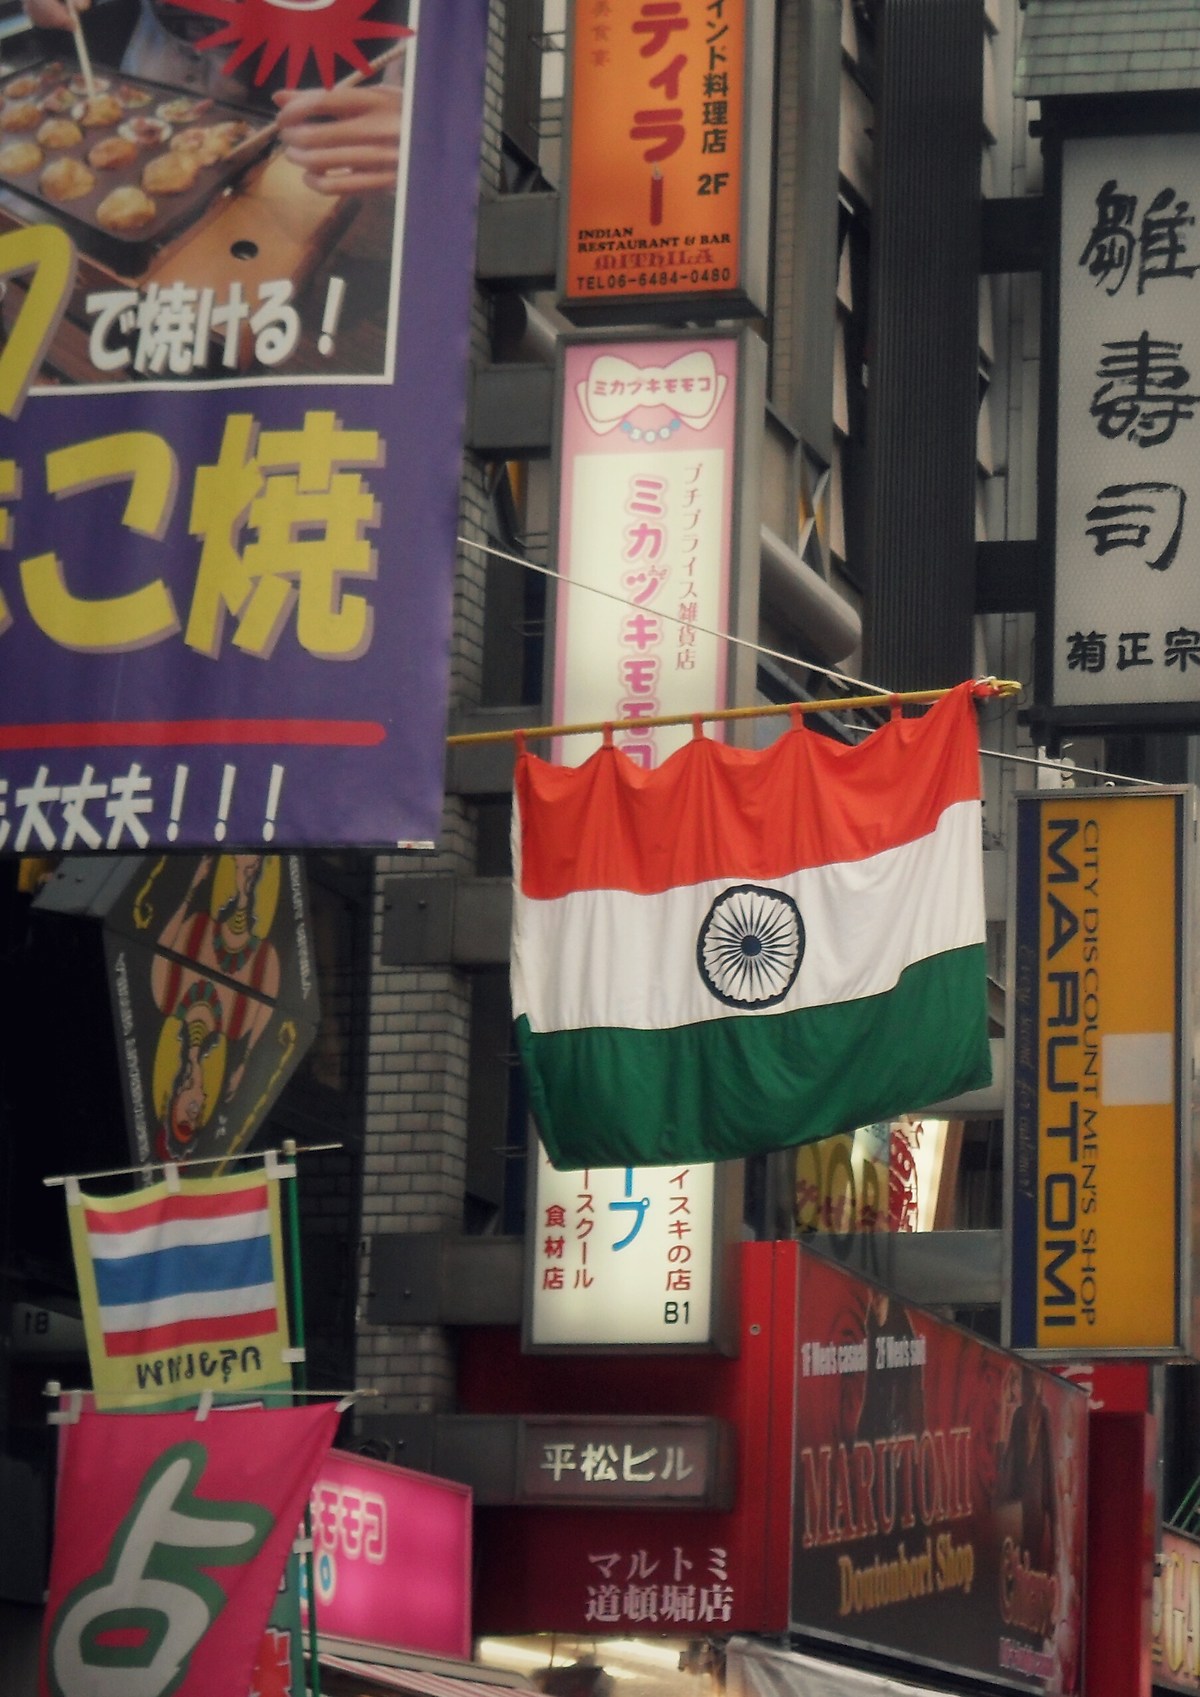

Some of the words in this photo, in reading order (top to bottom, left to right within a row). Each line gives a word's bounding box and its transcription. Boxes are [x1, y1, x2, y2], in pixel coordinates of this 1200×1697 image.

[697, 173, 730, 195] 2F
[577, 236, 680, 253] RESTAURANT
[700, 234, 732, 245] BAR
[578, 227, 634, 240] INDIAN
[0, 410, 387, 660] こ焼
[0, 763, 285, 851] 大丈夫！！！
[1082, 818, 1100, 897] CITY
[1080, 908, 1101, 1094] DISCOUNT
[1041, 818, 1080, 1328] MARUTOMI
[1080, 1107, 1098, 1215] MEN'S
[541, 1204, 567, 1291] 食材店
[1079, 1228, 1097, 1327] SHOP
[664, 1301, 690, 1325] B1
[540, 1441, 695, 1483] 平松ビル
[801, 1426, 973, 1549] MARUTOMI
[585, 1585, 735, 1623] 道頓堀店
[588, 1547, 729, 1583] マルトミ
